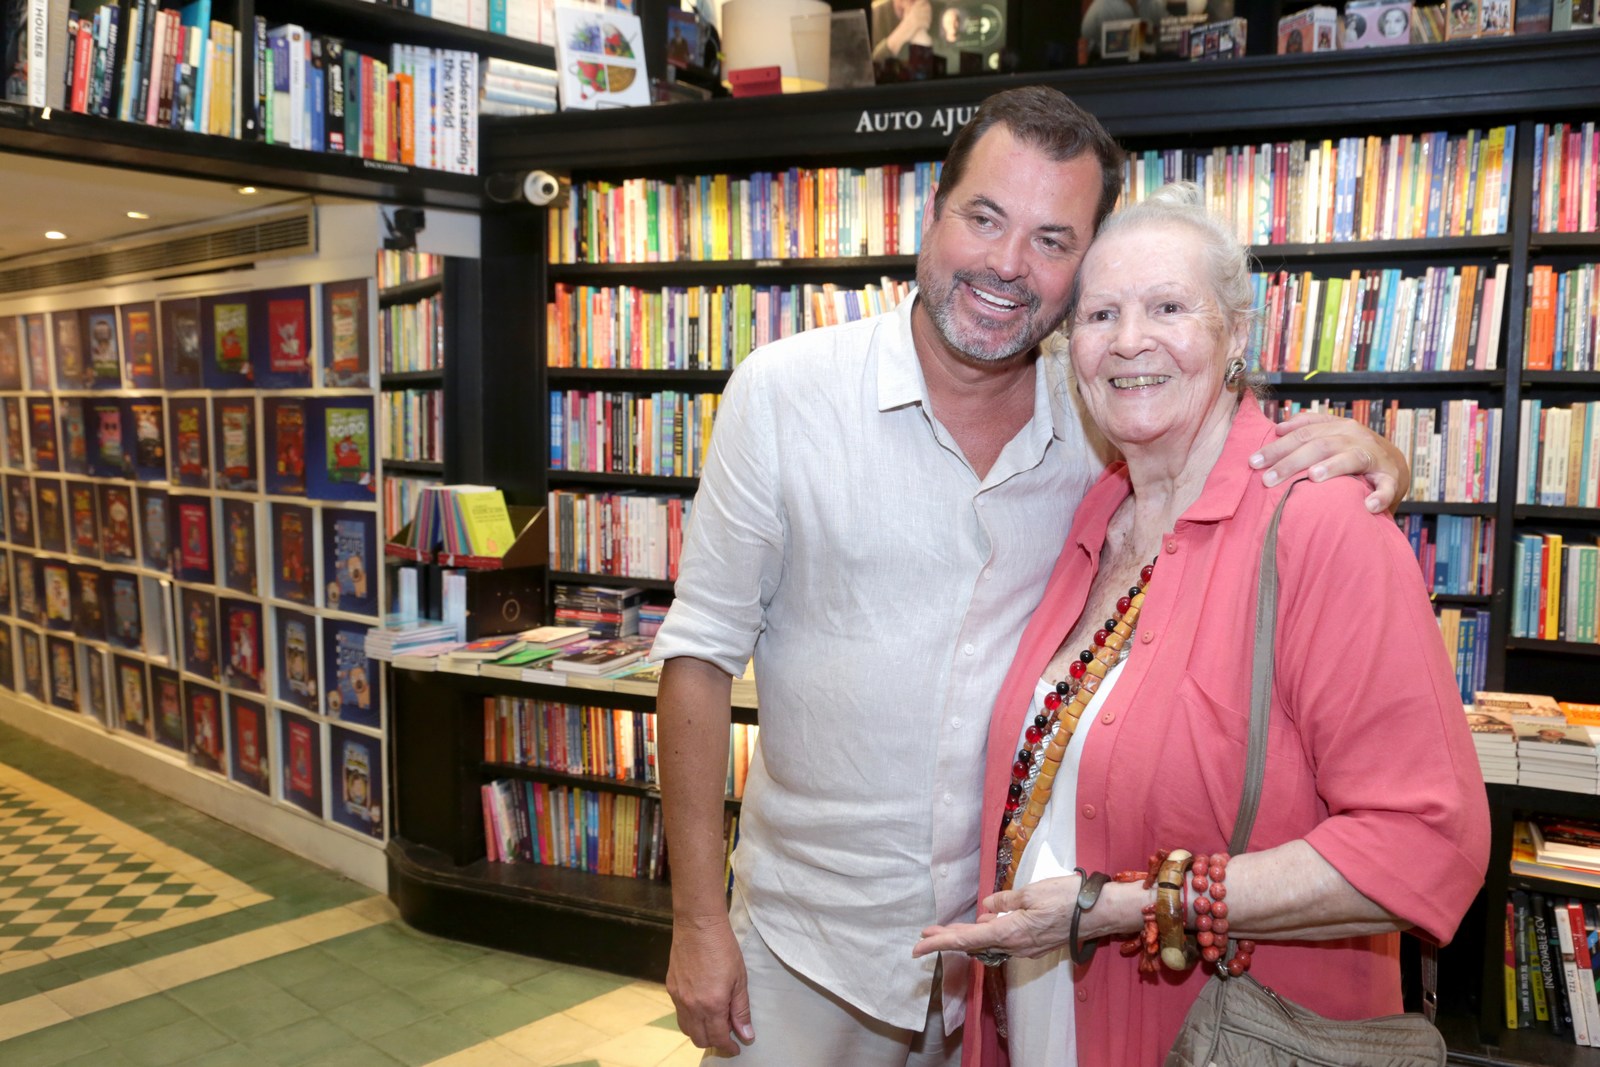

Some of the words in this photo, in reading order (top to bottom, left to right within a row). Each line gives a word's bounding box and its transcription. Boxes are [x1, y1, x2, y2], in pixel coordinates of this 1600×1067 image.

[34, 8, 44, 58] HOUSES
[444, 59, 455, 80] the
[444, 87, 455, 129] World
[457, 60, 471, 166] Understanding
[930, 106, 980, 136] AJU
[1535, 915, 1546, 934] 2CV
[1539, 935, 1555, 989] INCROYABLE
